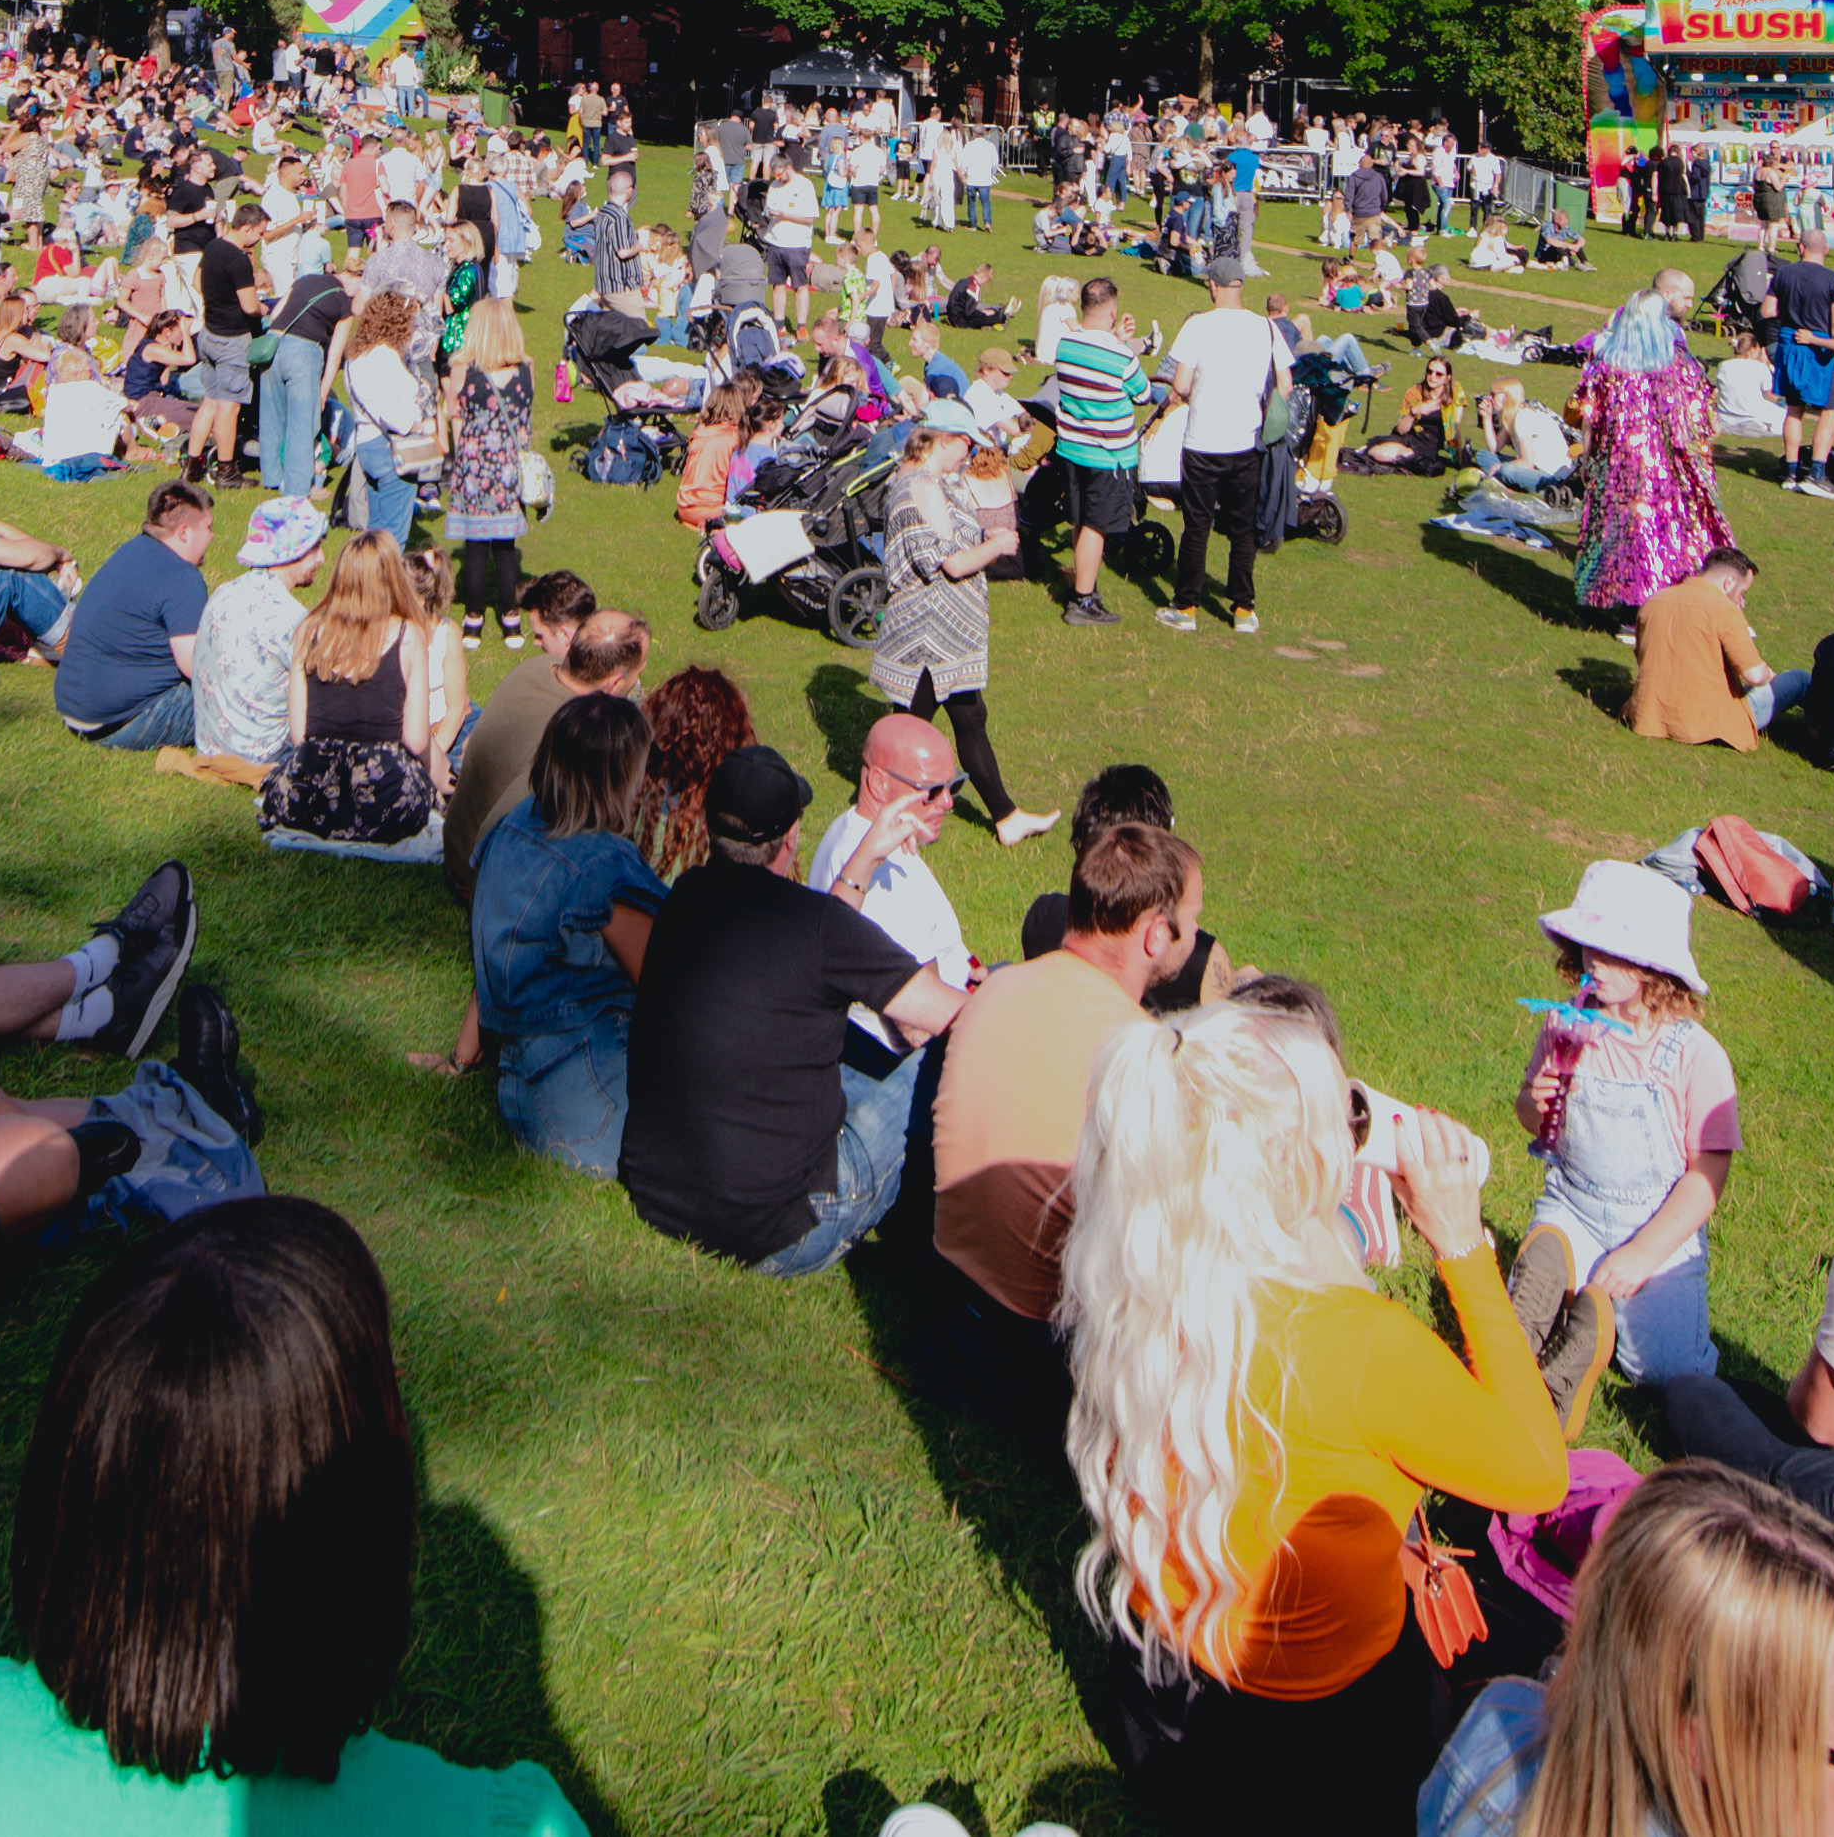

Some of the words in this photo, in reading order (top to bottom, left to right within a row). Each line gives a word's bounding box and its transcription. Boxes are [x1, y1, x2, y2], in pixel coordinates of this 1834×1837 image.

[1684, 10, 1824, 42] SLUSH
[1675, 56, 1782, 73] TROPICAL
[1680, 86, 1703, 96] MIX
[1704, 86, 1715, 96] IT
[1716, 86, 1733, 96] UP
[1805, 89, 1829, 99] MIX
[1743, 99, 1795, 110] CREATE
[1771, 112, 1795, 120] OWN
[1742, 120, 1796, 134] SLUSH
